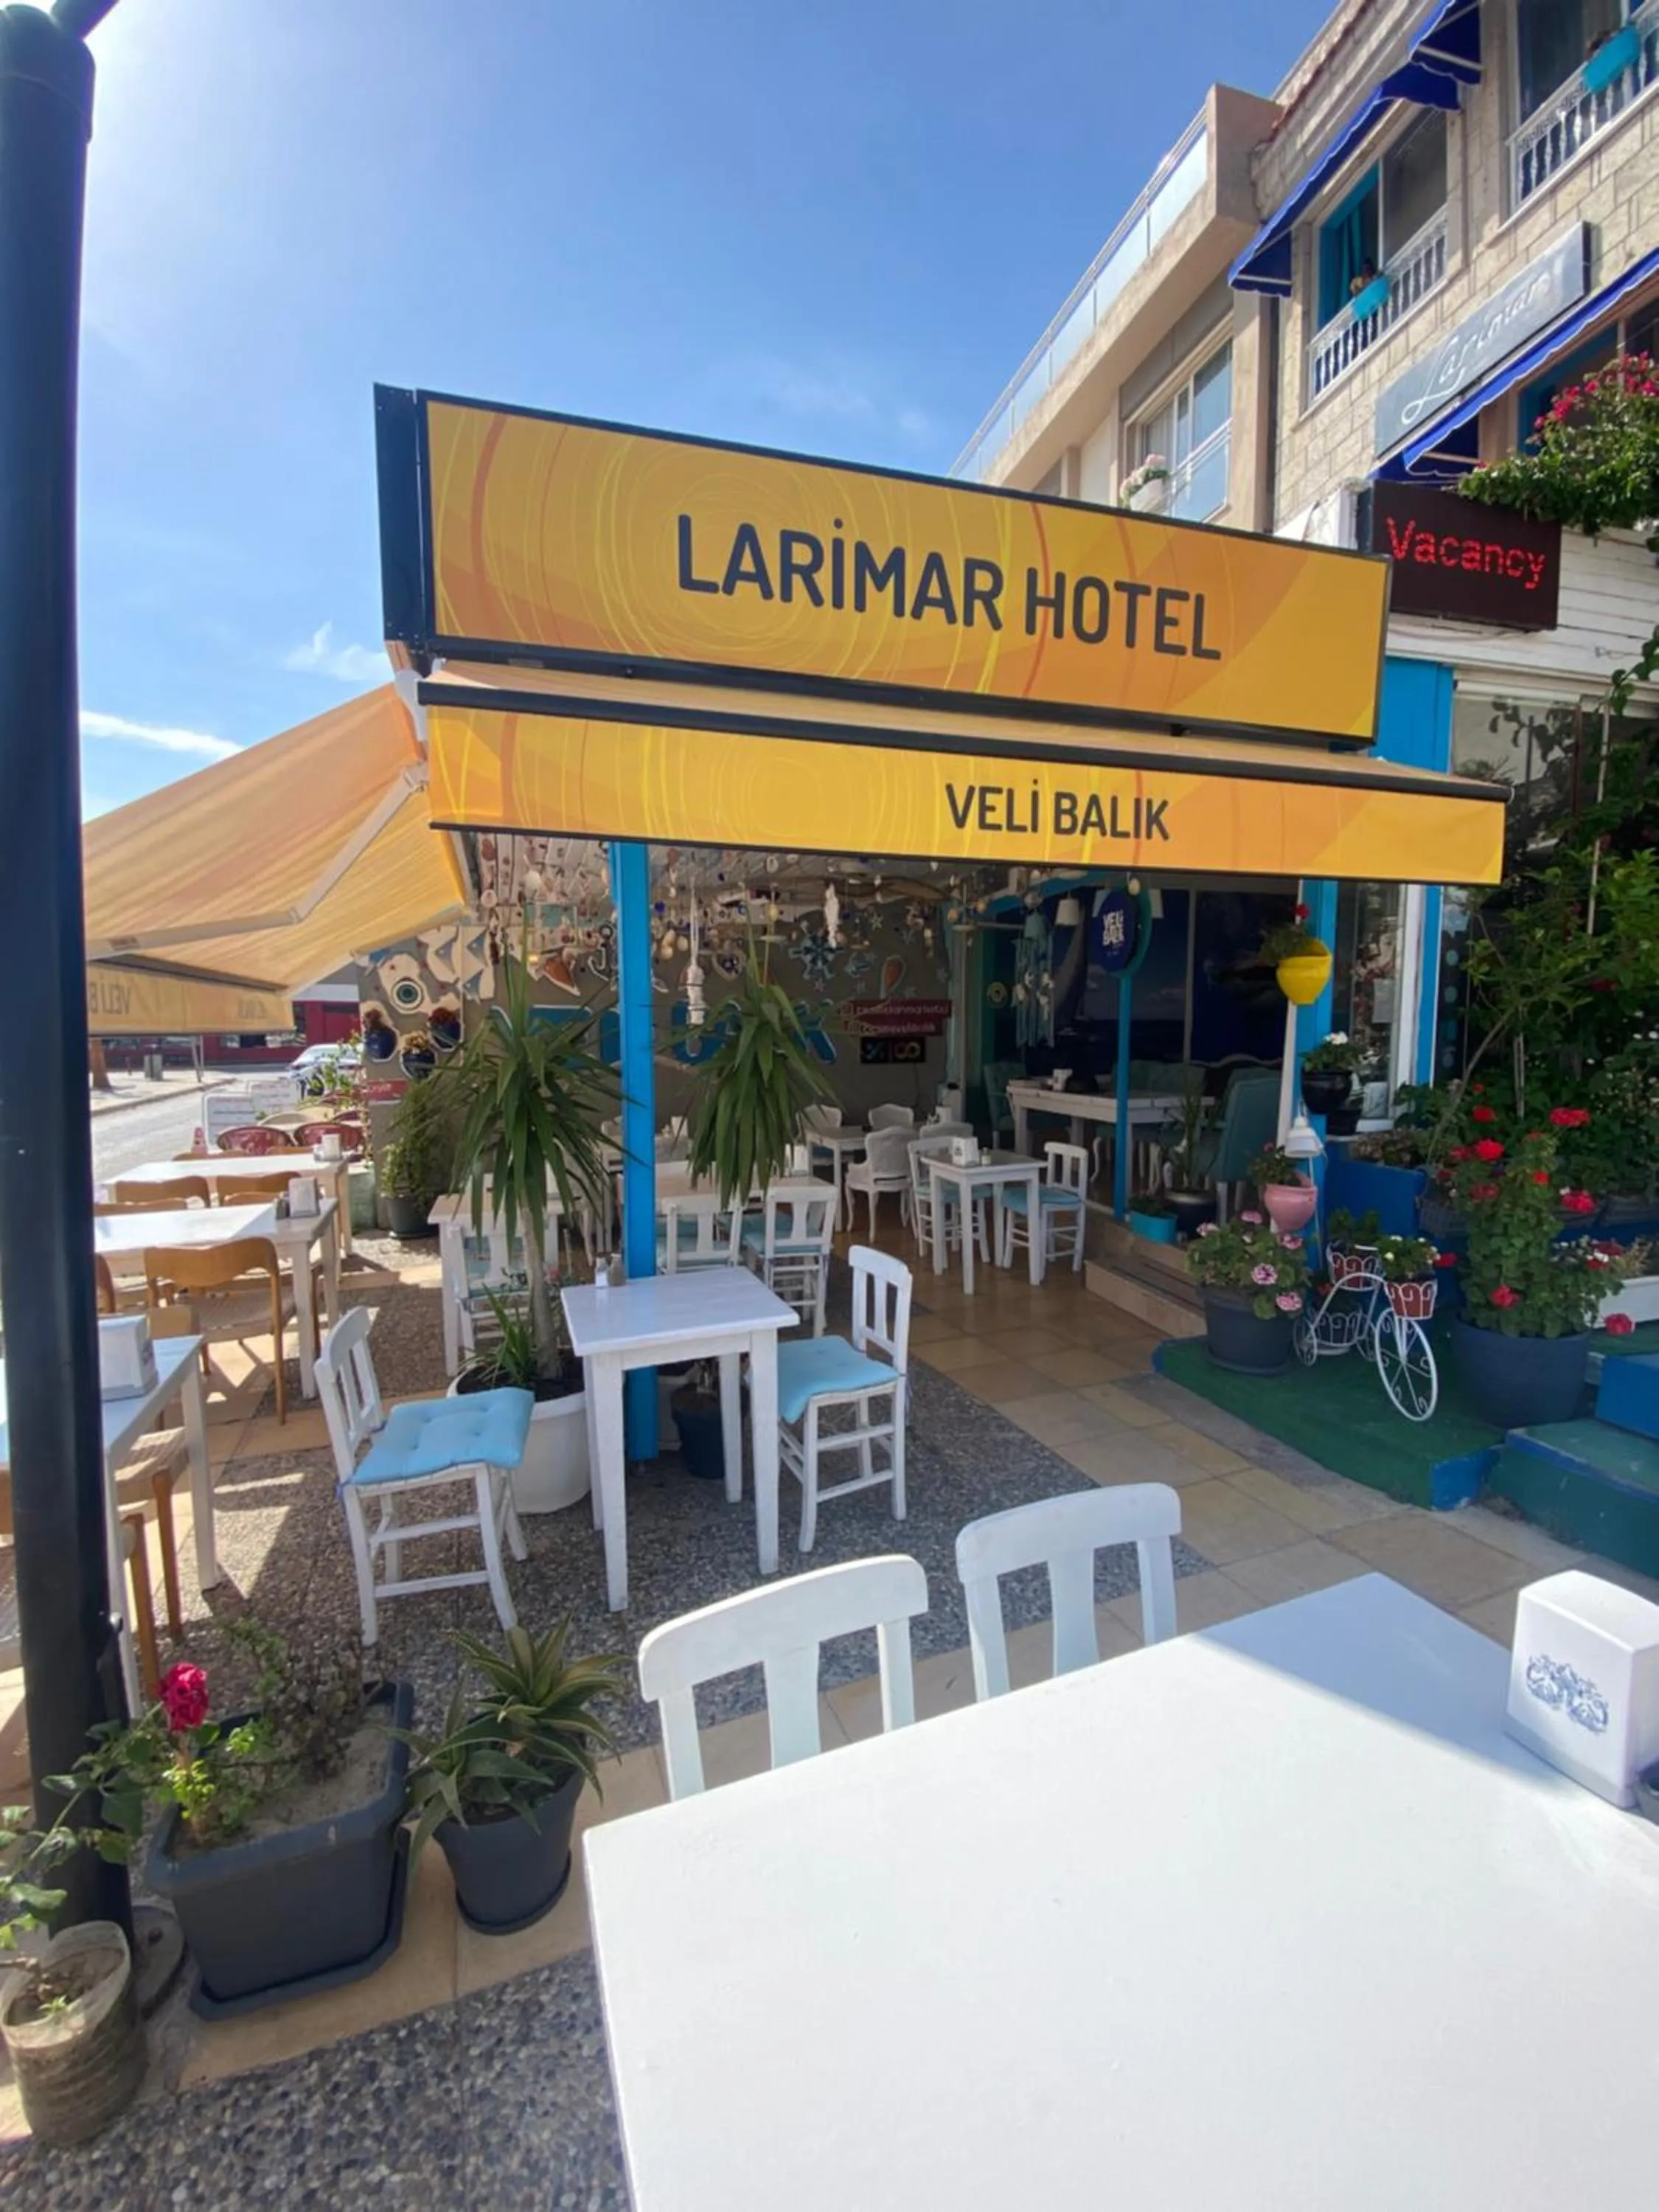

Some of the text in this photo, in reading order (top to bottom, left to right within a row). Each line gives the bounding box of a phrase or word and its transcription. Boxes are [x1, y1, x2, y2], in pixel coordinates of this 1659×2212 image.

[1401, 270, 1551, 425] Larimar
[677, 513, 1222, 661] LARİMAR HOTEL
[1386, 516, 1545, 589] Vacancy
[945, 779, 1170, 841] VELİ BALIK
